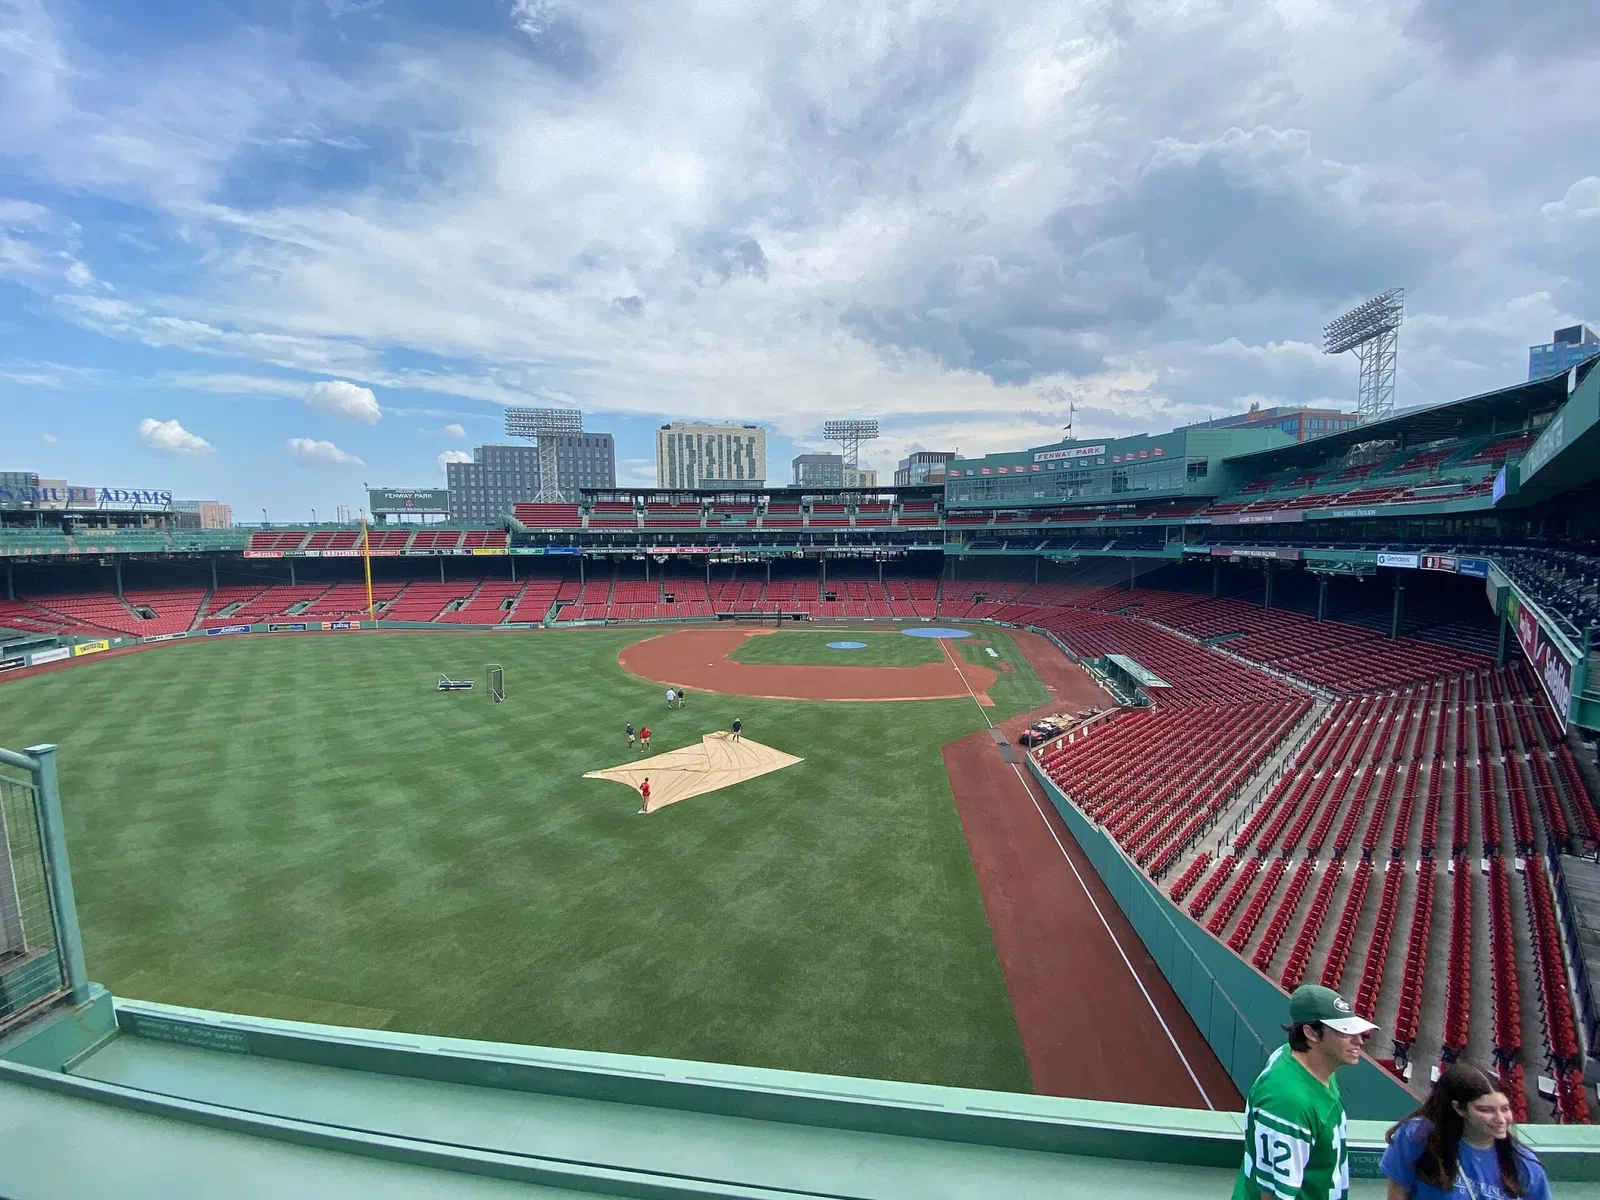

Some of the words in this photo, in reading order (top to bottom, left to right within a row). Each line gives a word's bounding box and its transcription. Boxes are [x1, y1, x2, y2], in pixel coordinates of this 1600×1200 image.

[1247, 411, 1268, 420] Optum
[1038, 450, 1072, 460] FENWAY
[1076, 447, 1101, 455] PARK
[0, 486, 95, 502] SAMUEL
[99, 486, 173, 506] ADAMS
[1544, 646, 1569, 717] Safelite
[1260, 1133, 1292, 1177] 12
